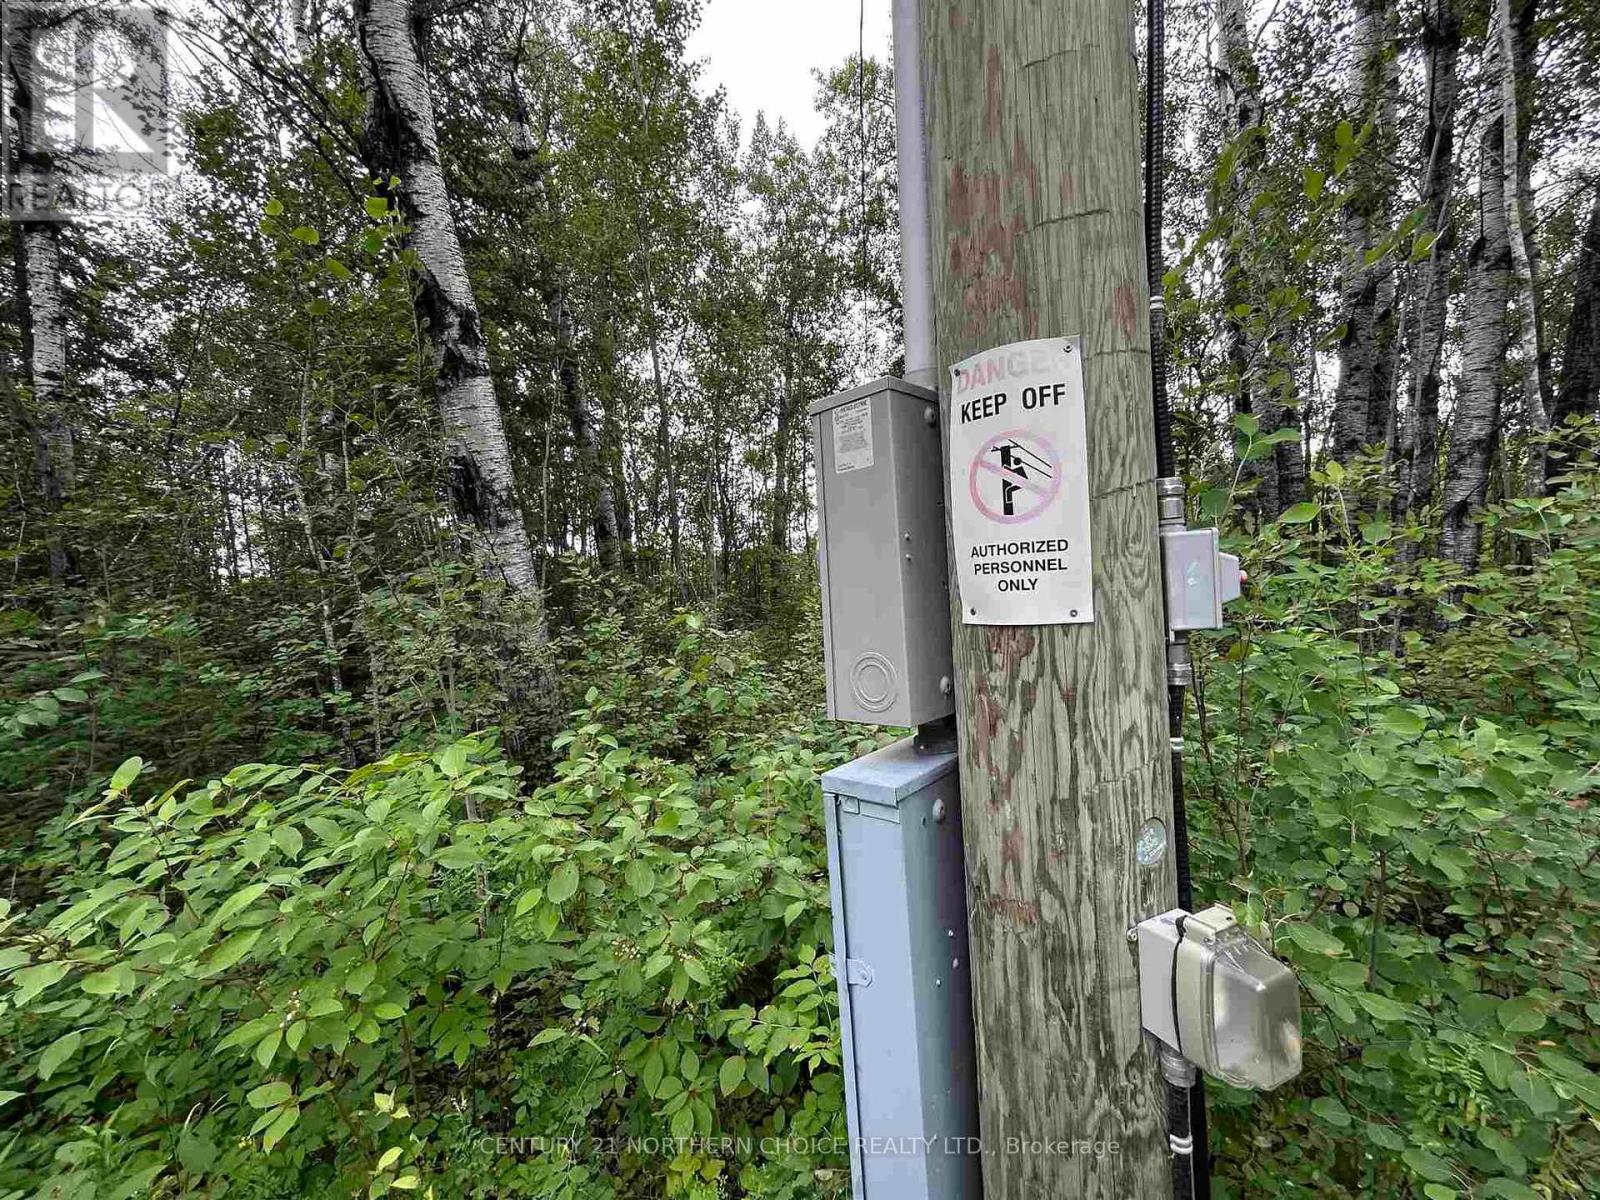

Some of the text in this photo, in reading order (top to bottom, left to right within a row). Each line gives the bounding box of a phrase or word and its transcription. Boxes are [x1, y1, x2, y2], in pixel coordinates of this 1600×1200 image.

[956, 348, 1071, 394] DANGE
[961, 383, 1066, 424] KEEP OFF
[970, 539, 1069, 558] AUTHORIZED
[974, 558, 1067, 575] PERSONNEL
[998, 578, 1038, 592] ONLY
